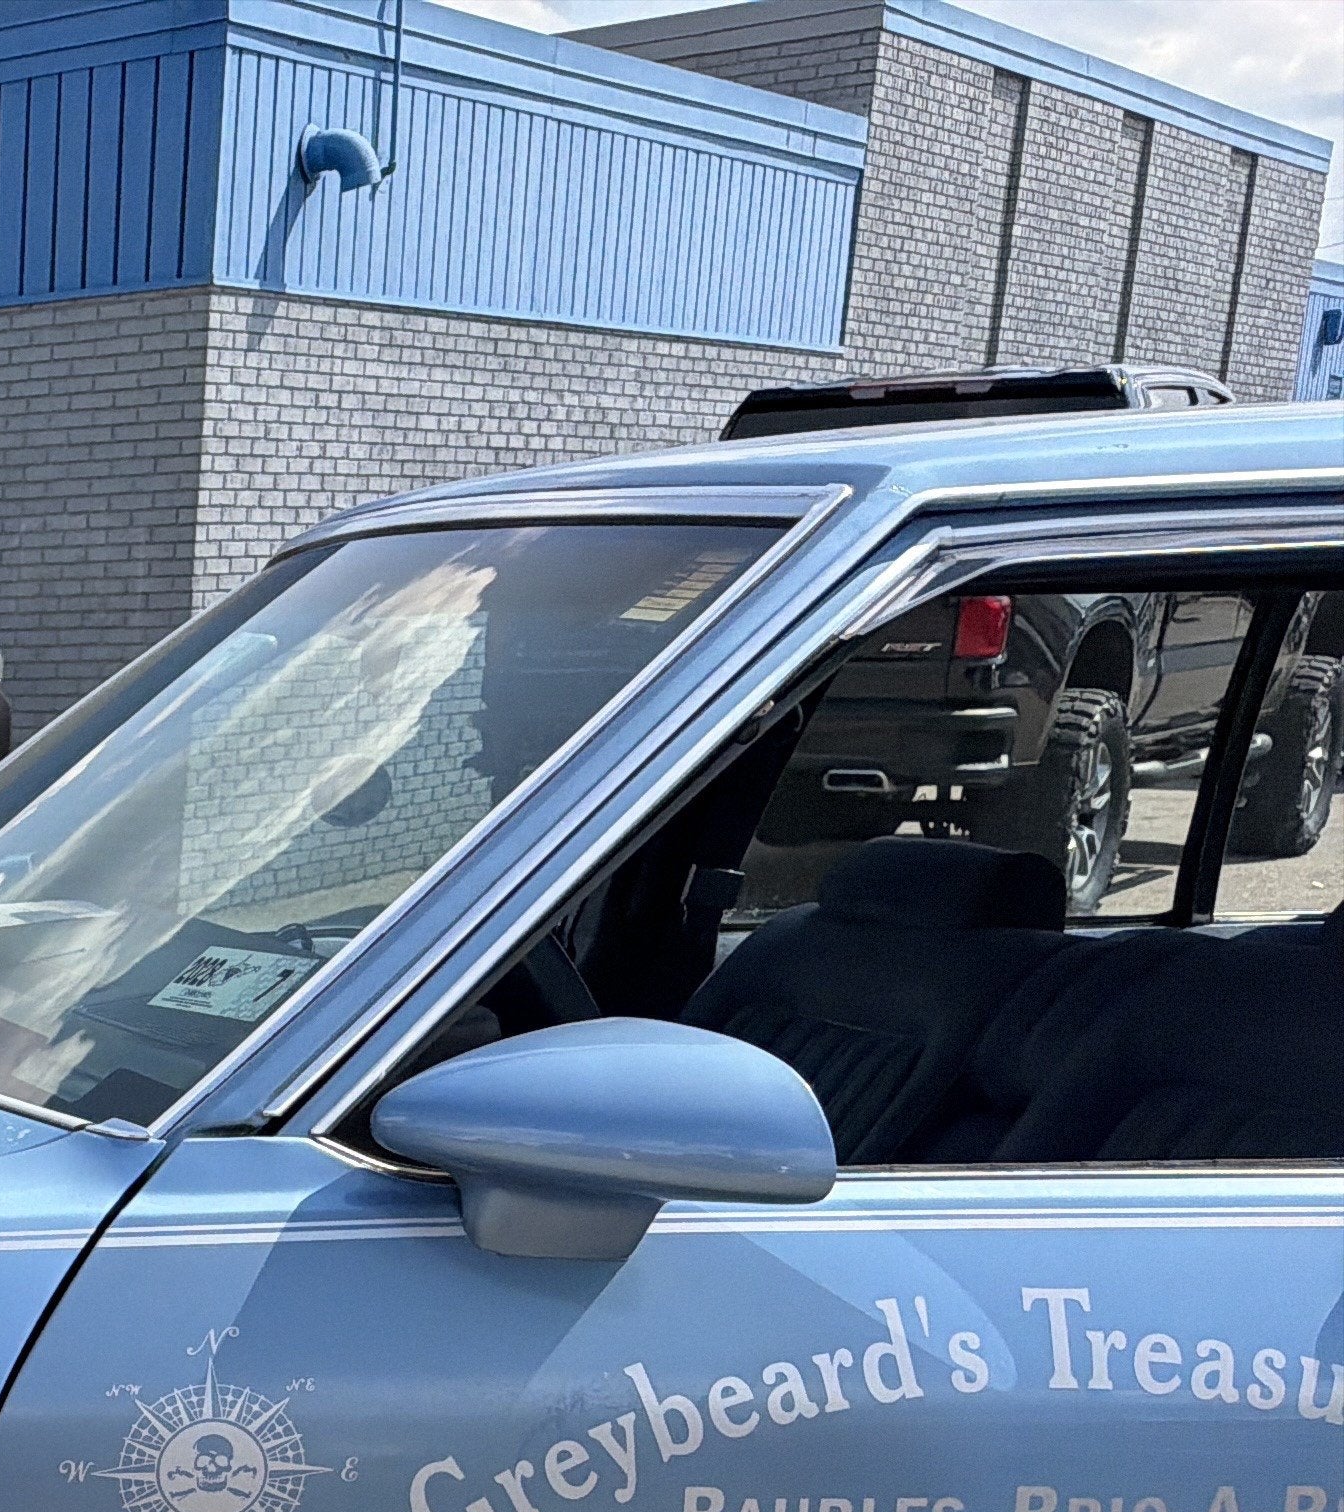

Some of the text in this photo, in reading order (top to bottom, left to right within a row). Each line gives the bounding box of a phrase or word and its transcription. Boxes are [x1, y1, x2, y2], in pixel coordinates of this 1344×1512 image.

[186, 1326, 240, 1356] N
[1021, 1286, 1344, 1425] Treasu
[58, 1459, 95, 1483] W
[340, 1457, 359, 1483] E
